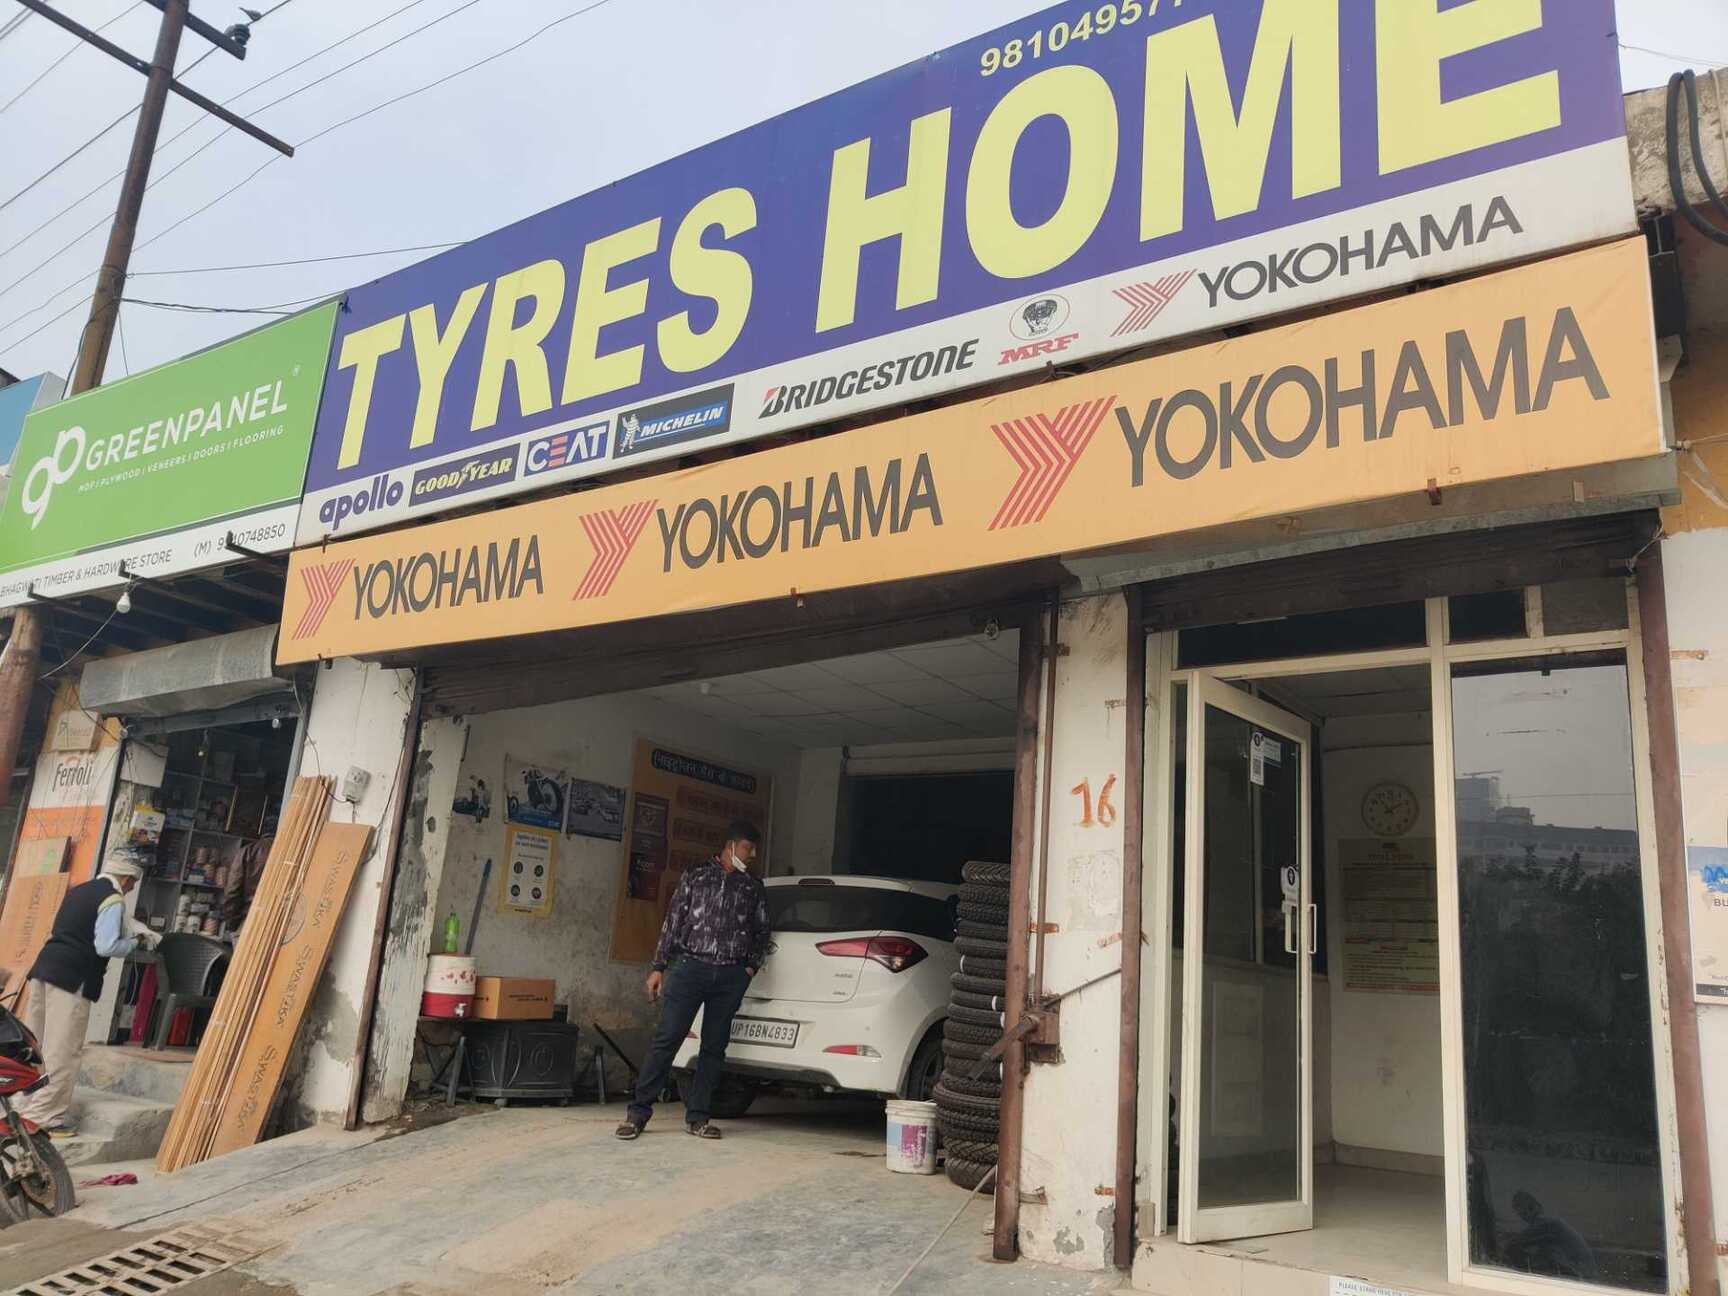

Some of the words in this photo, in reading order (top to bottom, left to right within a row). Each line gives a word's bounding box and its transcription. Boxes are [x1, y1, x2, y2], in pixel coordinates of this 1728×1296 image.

[337, 187, 758, 470] TYRES
[815, 0, 1563, 335] HOME
[1197, 195, 1523, 308] YOKOHAMA
[997, 332, 1080, 366] MRF
[758, 339, 979, 419] BRIDGESTONE
[1115, 306, 1610, 488] YOKOHAMA
[86, 380, 288, 471] GREENPANEL
[233, 425, 285, 449] FLOORING
[528, 426, 607, 472] CEAT
[641, 406, 724, 437] MICHELIN
[319, 473, 404, 531] apollo
[656, 453, 944, 574] YOKOHAMA
[43, 568, 74, 588] TIMBER
[84, 557, 138, 577] HARDWRE
[140, 549, 173, 568] STORE
[193, 541, 212, 558] (M)
[353, 534, 544, 621] YOKOHAMA
[52, 761, 93, 792] Ferroli
[1072, 774, 1117, 828] 16
